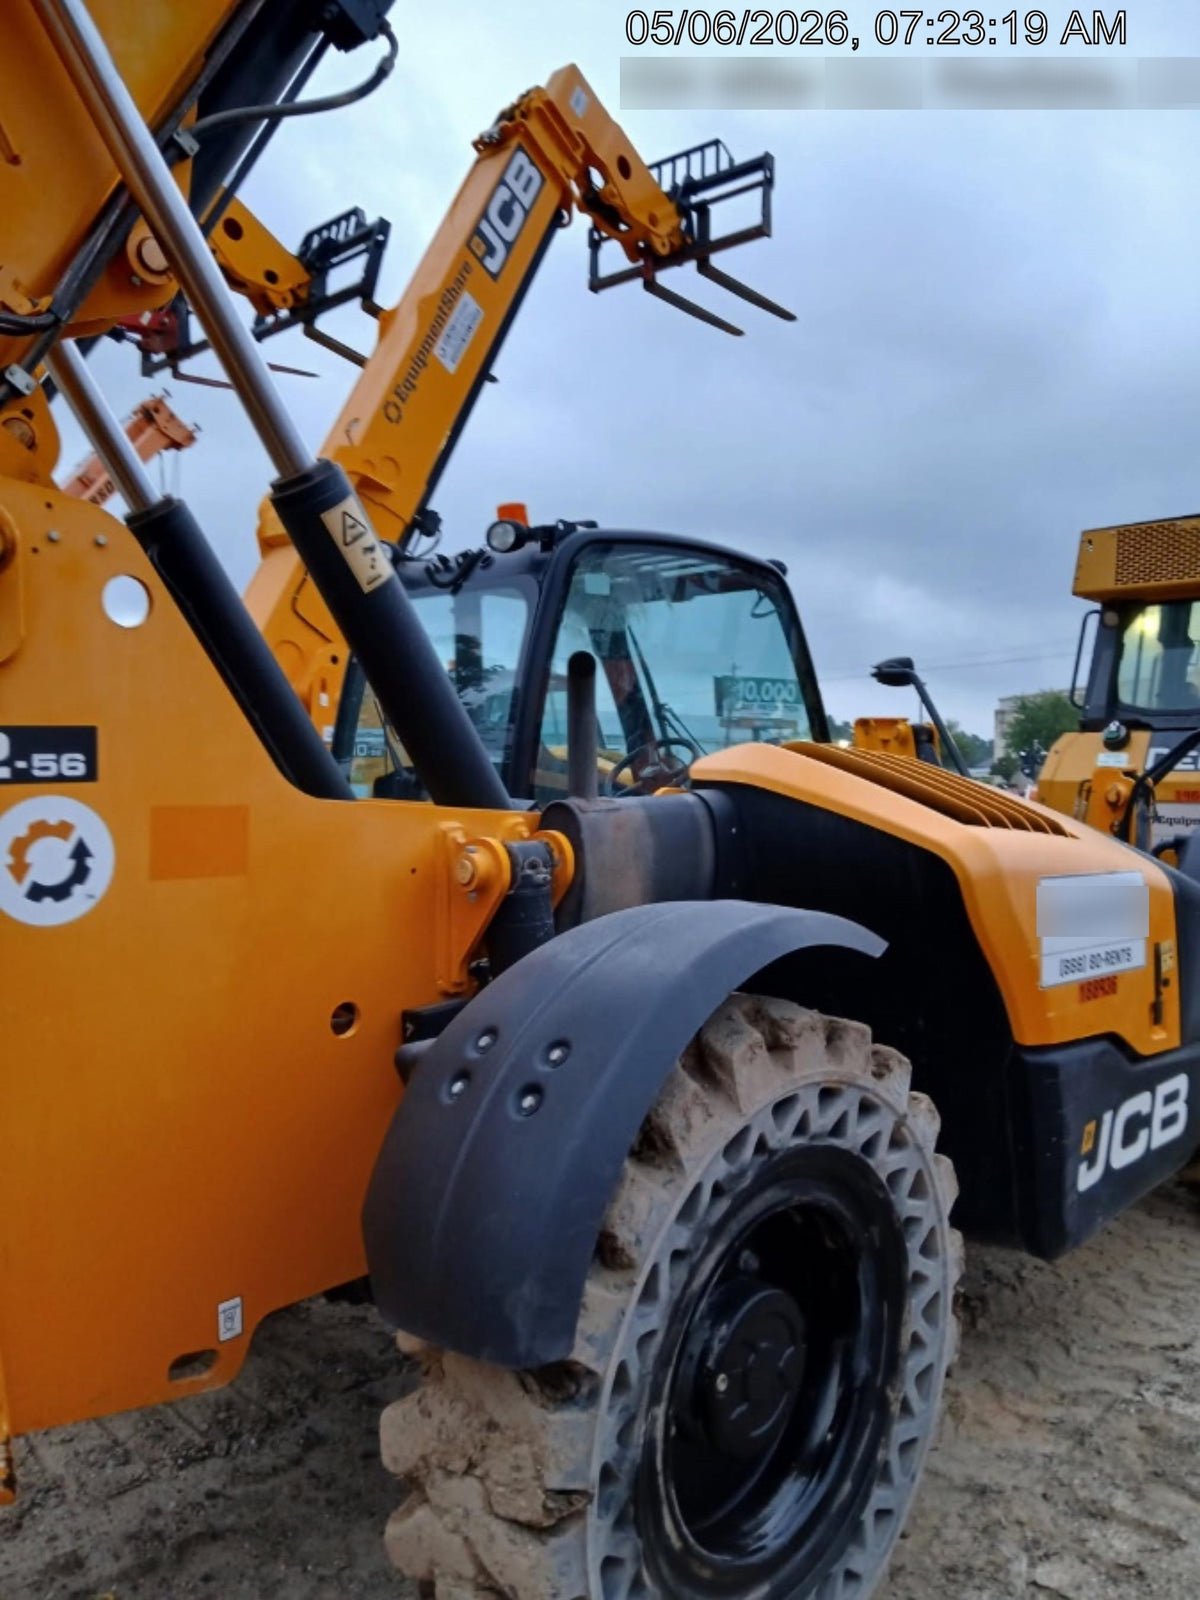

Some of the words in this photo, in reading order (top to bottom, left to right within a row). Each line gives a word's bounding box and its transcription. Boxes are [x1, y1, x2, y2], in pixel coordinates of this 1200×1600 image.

[479, 149, 544, 275] JCB
[394, 261, 473, 403] EquipmentShare
[1077, 1073, 1189, 1192] JCB
